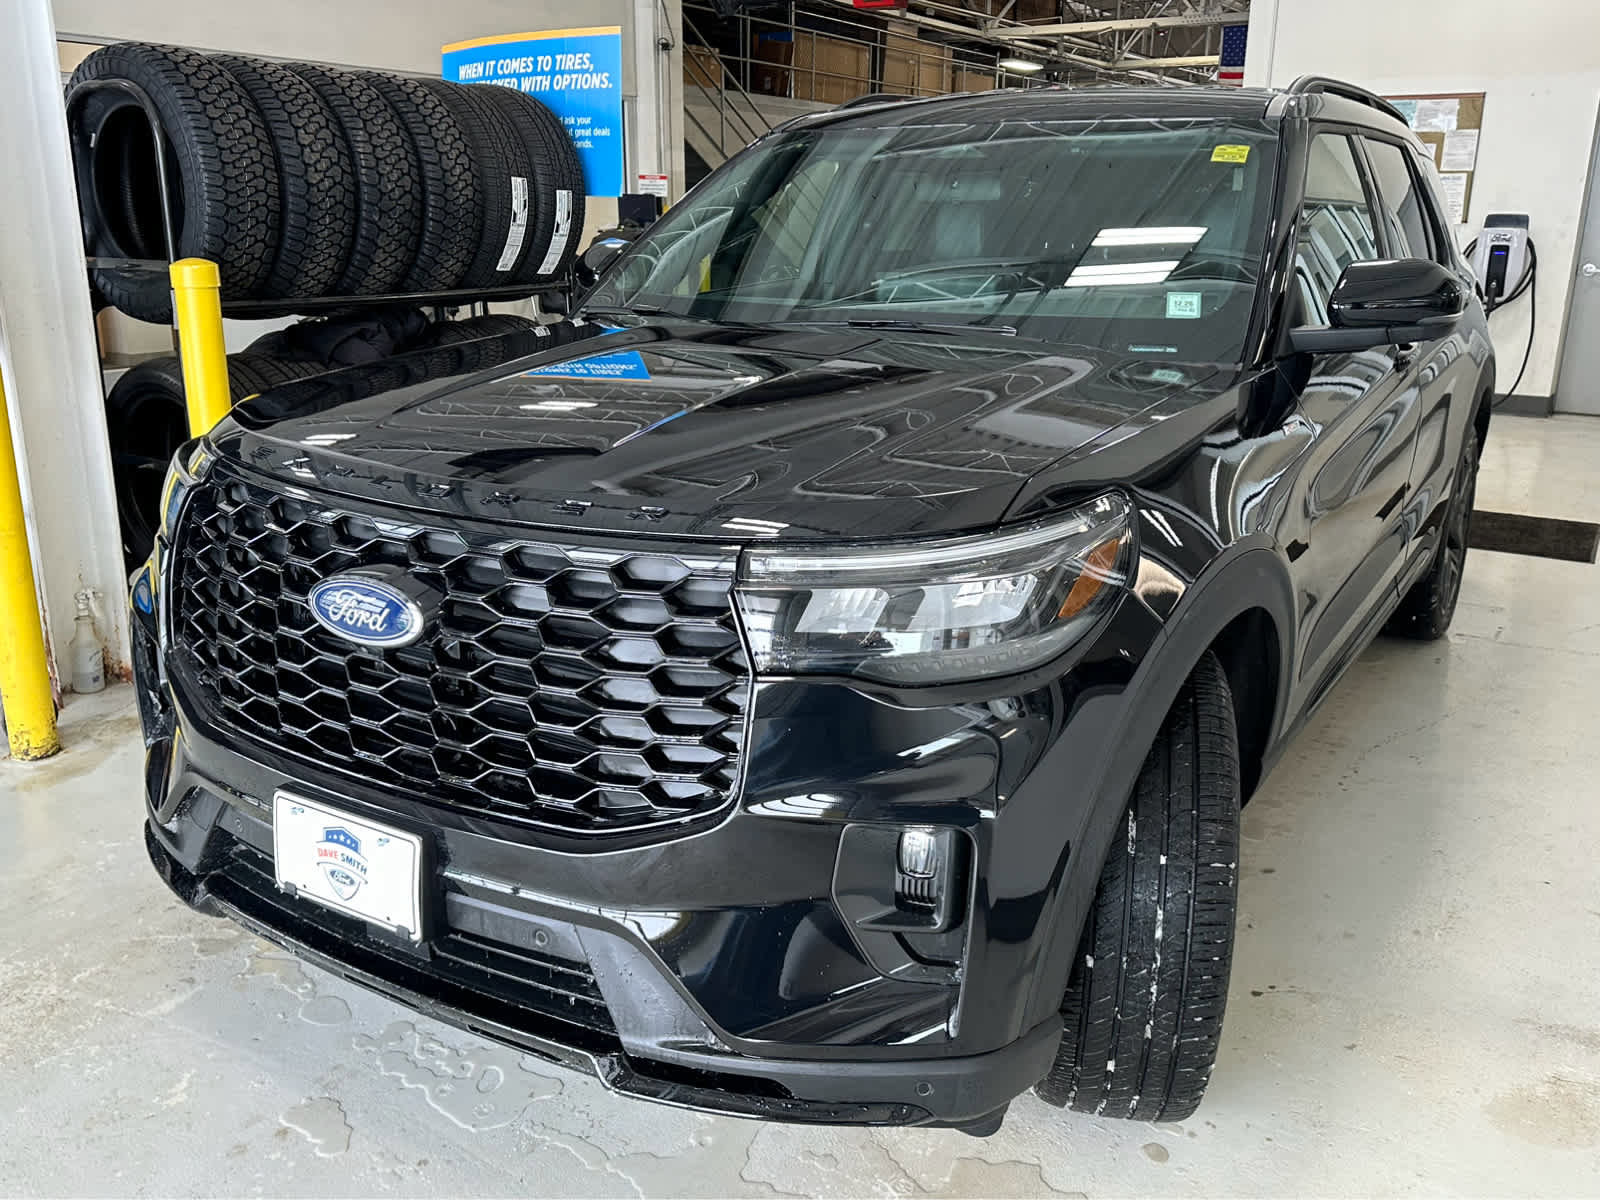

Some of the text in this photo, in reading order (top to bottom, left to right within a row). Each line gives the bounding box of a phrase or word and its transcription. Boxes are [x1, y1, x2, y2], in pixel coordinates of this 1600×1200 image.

[459, 53, 594, 80] WHEN IT COMES TO TIRES,
[521, 75, 551, 92] WITH
[553, 72, 613, 90] OPTIONS.
[564, 115, 576, 125] ask
[576, 117, 592, 127] your
[575, 128, 592, 139] great
[593, 127, 611, 136] deals
[573, 139, 594, 148] rands.
[328, 589, 391, 632] Ford
[317, 848, 367, 876] DAVE SMITH
